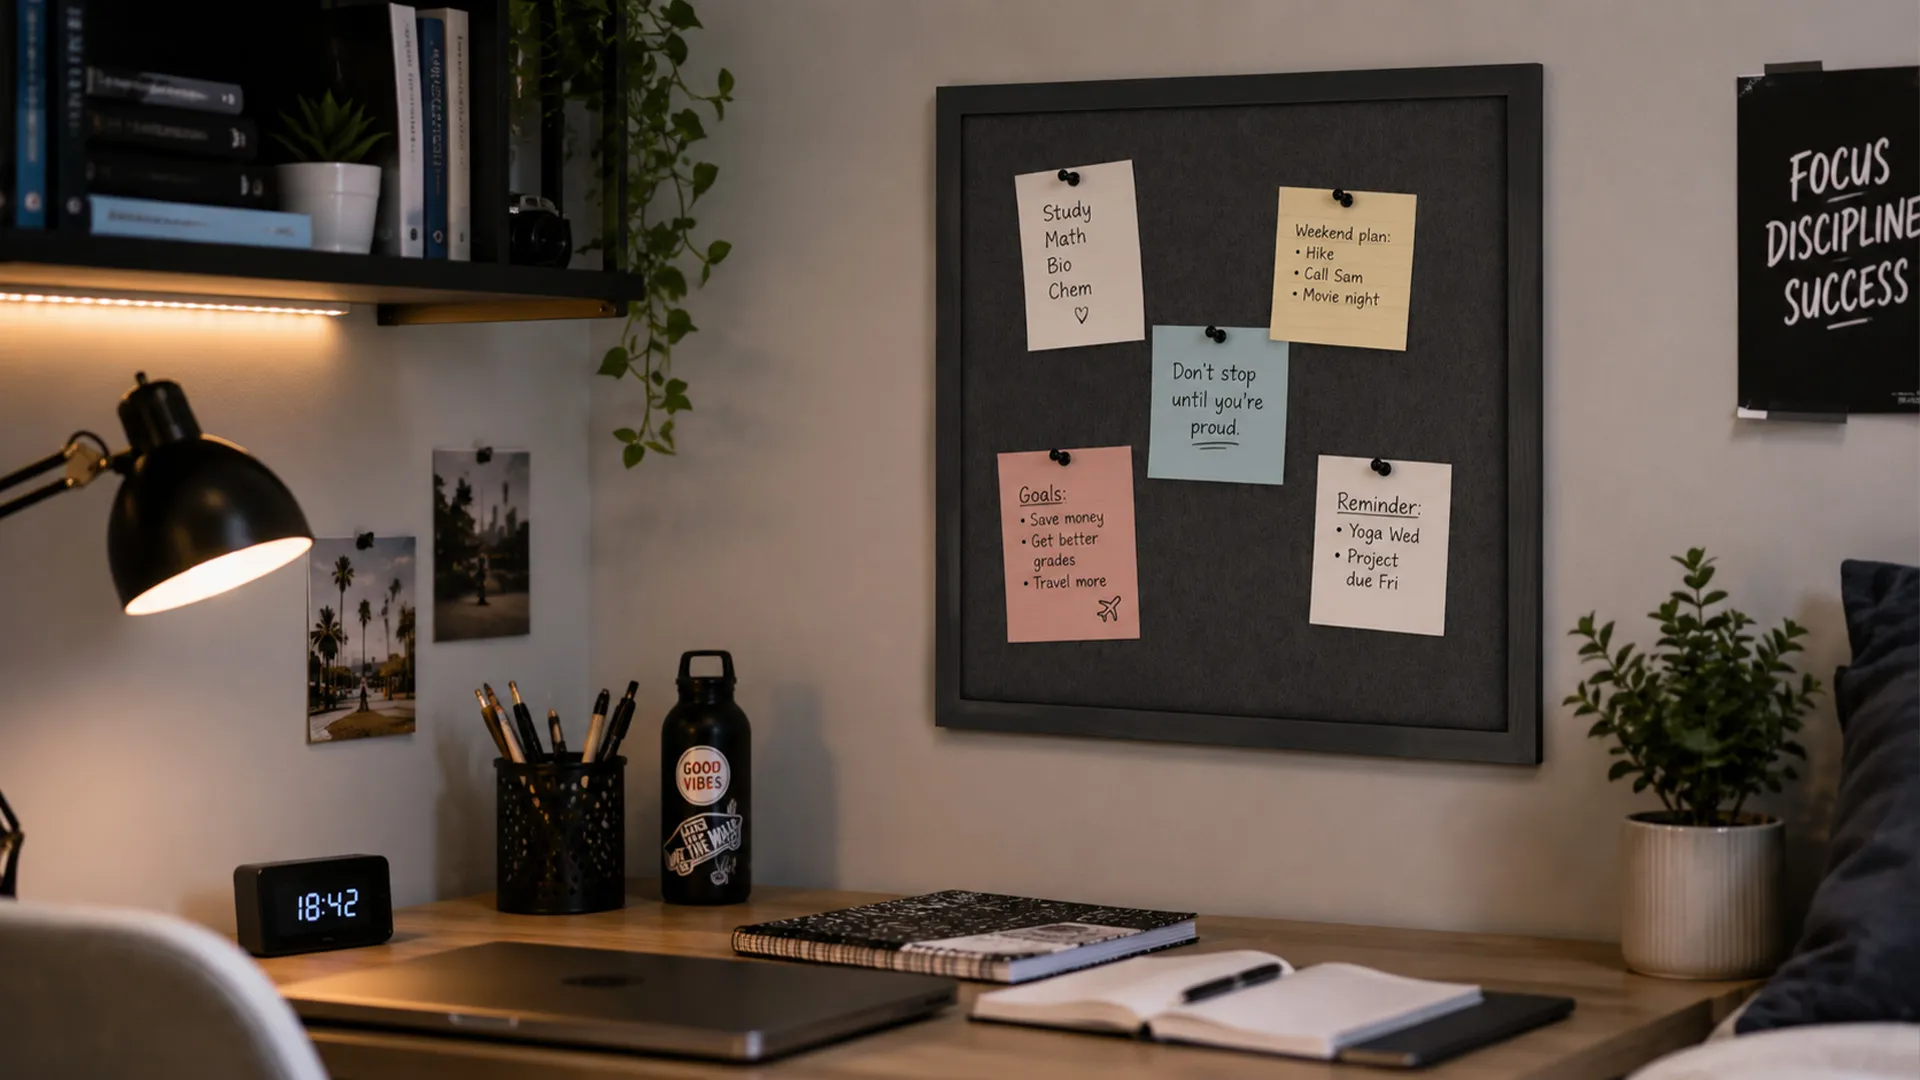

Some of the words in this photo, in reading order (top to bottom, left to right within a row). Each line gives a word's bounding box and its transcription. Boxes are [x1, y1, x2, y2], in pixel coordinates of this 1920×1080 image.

[1789, 137, 1891, 202] FOCUS
[1042, 199, 1092, 224] Study
[1045, 227, 1087, 249] Math
[1295, 223, 1354, 241] Weekend
[1358, 227, 1391, 246] plan:
[1765, 195, 1920, 267] DISCIPLINE
[1306, 246, 1334, 261] Hike
[1046, 256, 1072, 275] Bio
[1304, 266, 1329, 281] Call
[1334, 268, 1363, 284] Sam
[1048, 281, 1093, 300] Chem
[1302, 287, 1339, 304] Movie
[1345, 291, 1380, 310] night
[1784, 257, 1909, 326] SUCCESS
[1172, 361, 1215, 381] Don't
[1220, 364, 1256, 389] stop
[1171, 390, 1208, 408] until
[1215, 391, 1264, 415] you're
[1190, 418, 1240, 440] proud.
[1018, 485, 1067, 504] Goals:
[1336, 491, 1422, 519] Reminder:
[1030, 512, 1060, 527] Save
[1064, 512, 1104, 529] money
[1031, 533, 1054, 549] Get
[1058, 531, 1099, 547] better
[1349, 522, 1383, 546] Yoga
[1389, 526, 1420, 544] Wed
[1033, 552, 1076, 571] grades
[1347, 547, 1399, 571] Project
[1032, 573, 1070, 590] Travel
[1075, 576, 1107, 588] more
[1346, 572, 1373, 589] due
[1379, 573, 1399, 591] Fri
[683, 760, 721, 775] GOOD
[683, 776, 722, 791] VIBES
[298, 888, 359, 922] 18:42
